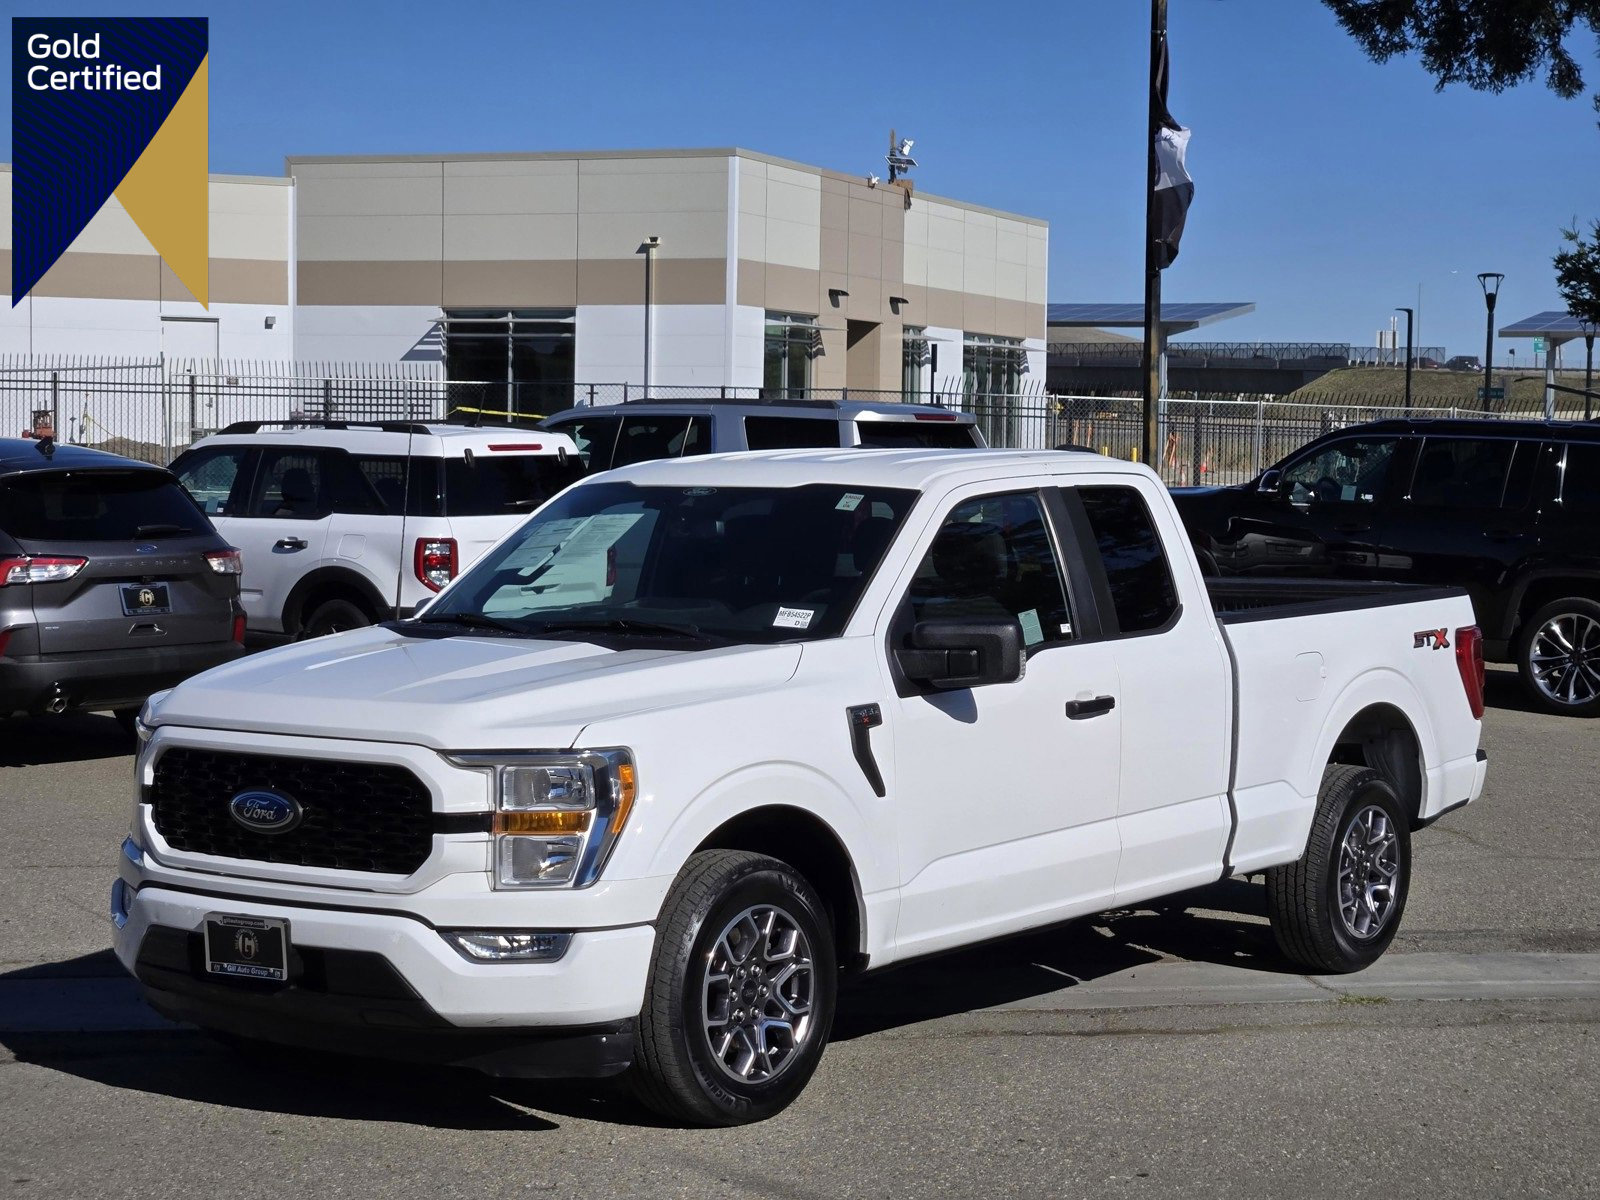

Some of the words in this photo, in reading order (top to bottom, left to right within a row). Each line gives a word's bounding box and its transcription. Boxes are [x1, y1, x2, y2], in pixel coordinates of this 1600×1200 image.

[1413, 627, 1450, 650] STX
[243, 799, 277, 820] Ford
[227, 963, 237, 972] Gill
[237, 965, 250, 974] Auto
[250, 967, 268, 976] Group
